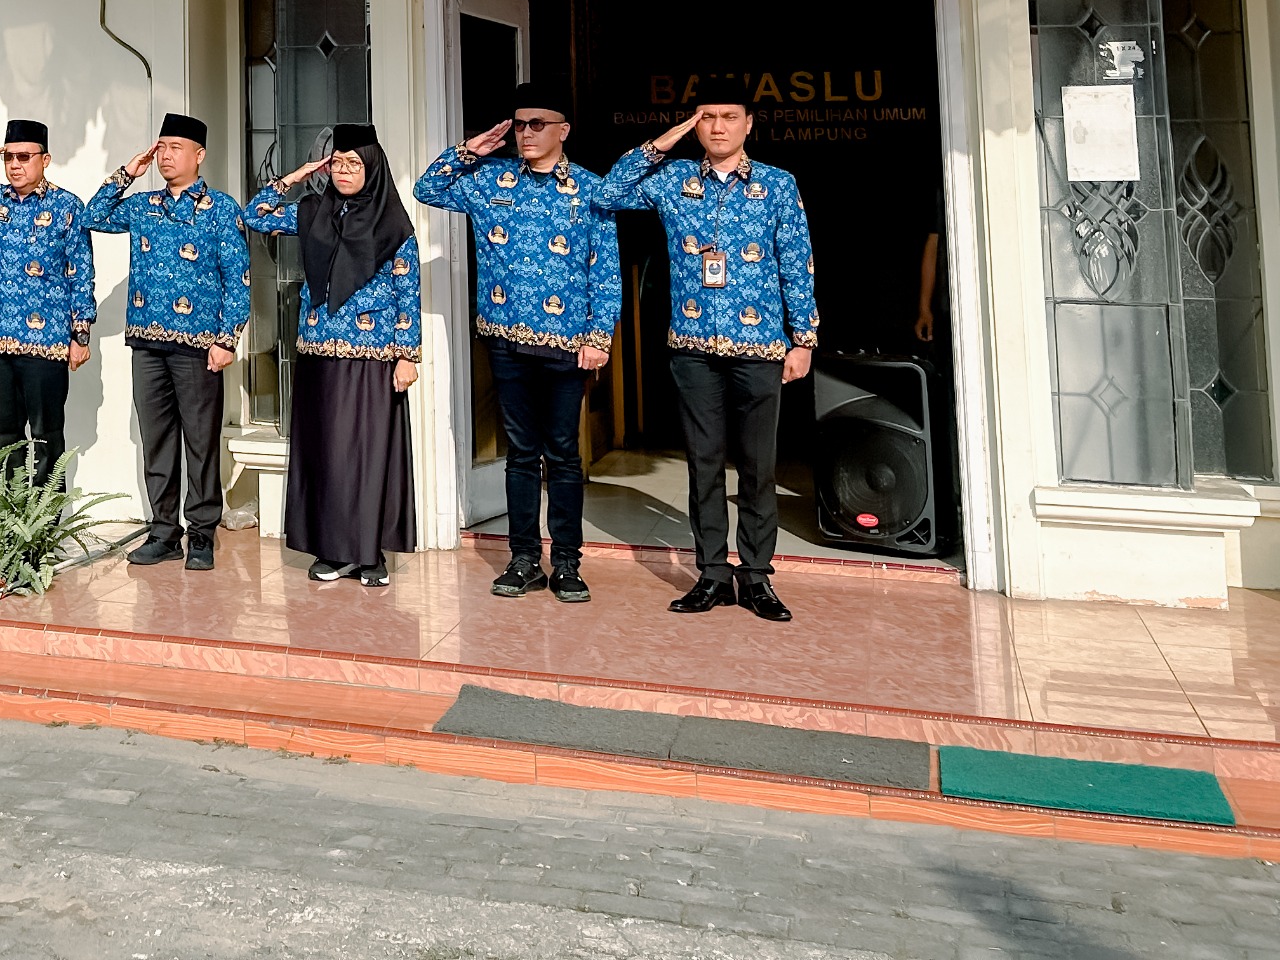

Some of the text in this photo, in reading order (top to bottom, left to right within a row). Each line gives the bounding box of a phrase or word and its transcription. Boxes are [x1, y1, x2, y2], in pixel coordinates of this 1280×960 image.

[651, 70, 883, 104] BAASLU
[614, 111, 670, 124] BADAN
[774, 108, 868, 122] PEMILIHAN
[873, 107, 926, 121] UMUM
[771, 127, 868, 141] LAMPUNG
